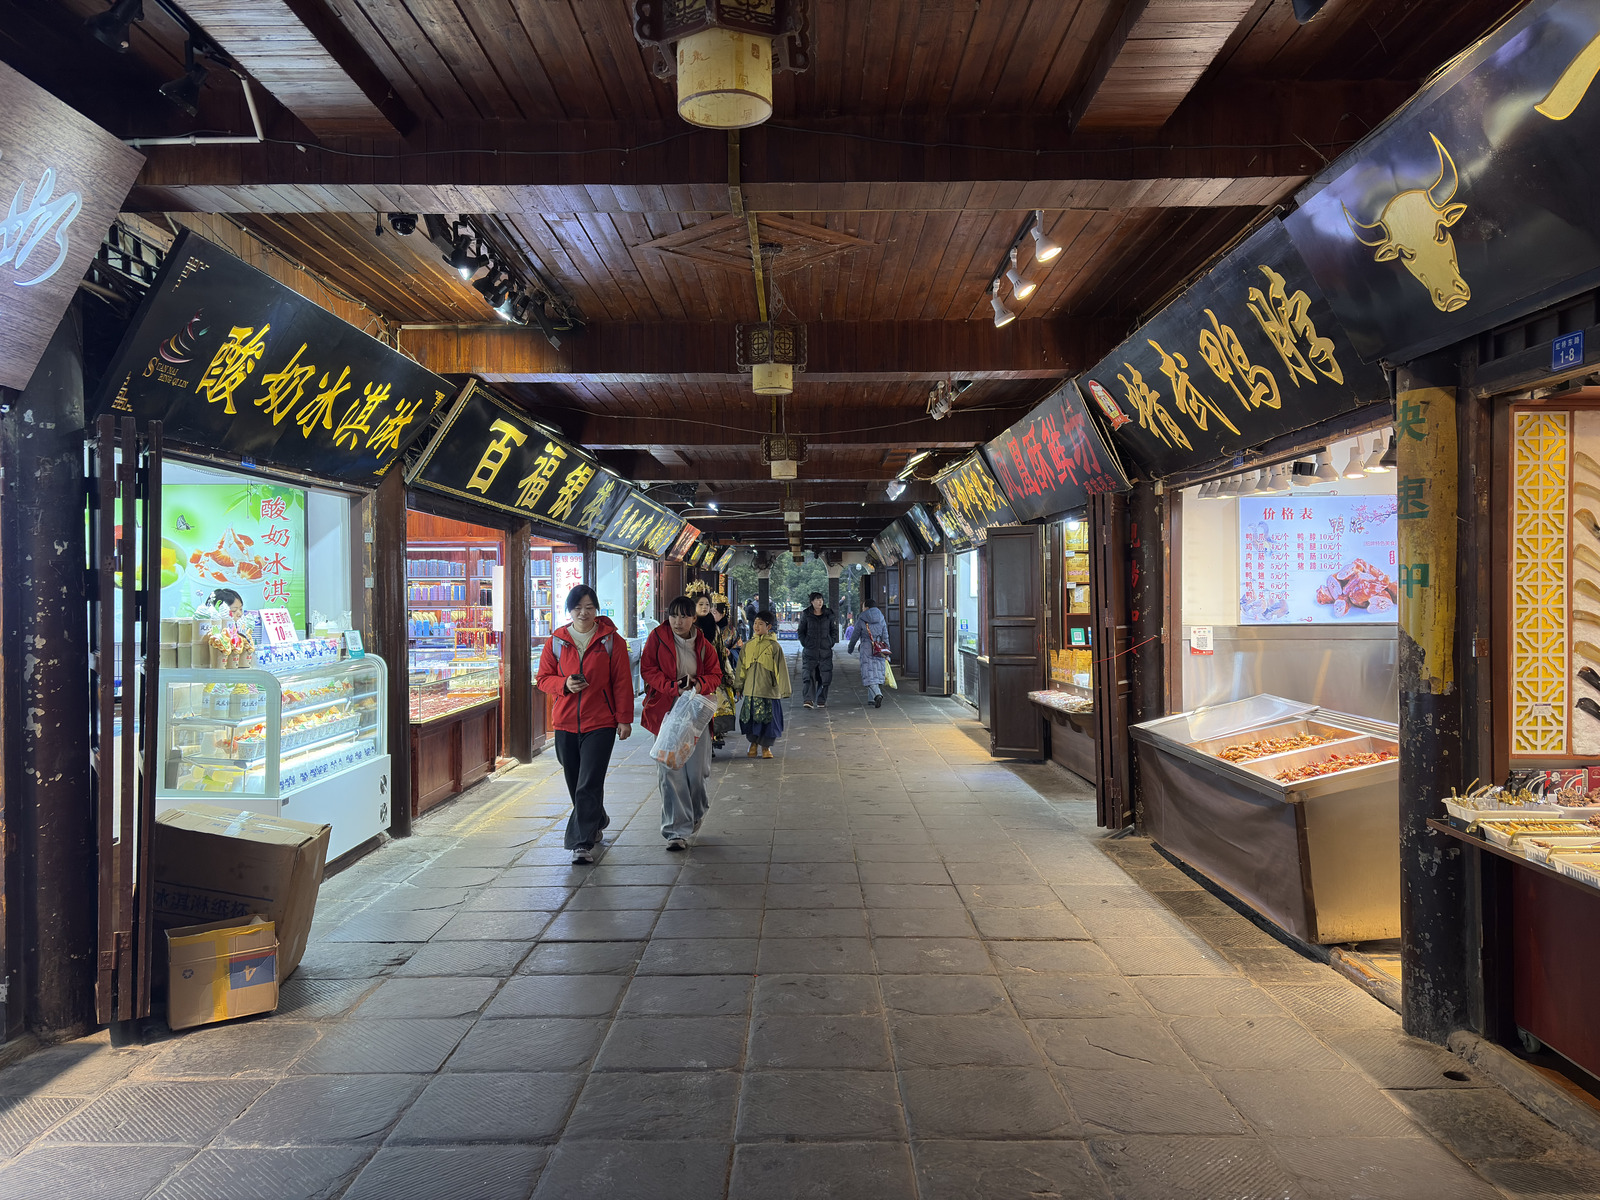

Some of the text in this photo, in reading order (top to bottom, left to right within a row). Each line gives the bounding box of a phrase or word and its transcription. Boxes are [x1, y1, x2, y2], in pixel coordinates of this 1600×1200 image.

[1117, 264, 1344, 451] 精武鸭脖
[1560, 348, 1575, 364] 1-8
[195, 322, 423, 459] 酸奶冰淇淋
[993, 398, 1102, 502] 凤凰酥鲜坊
[1263, 507, 1313, 520] 价格表
[1245, 533, 1265, 541] 鸭爪
[1320, 532, 1342, 541] 10元/个
[260, 495, 292, 610] 酸奶冰淇
[1320, 542, 1342, 551] 10元/个
[1320, 552, 1342, 561] 10元/个
[1320, 562, 1342, 571] 16元/个
[275, 626, 286, 641] 10
